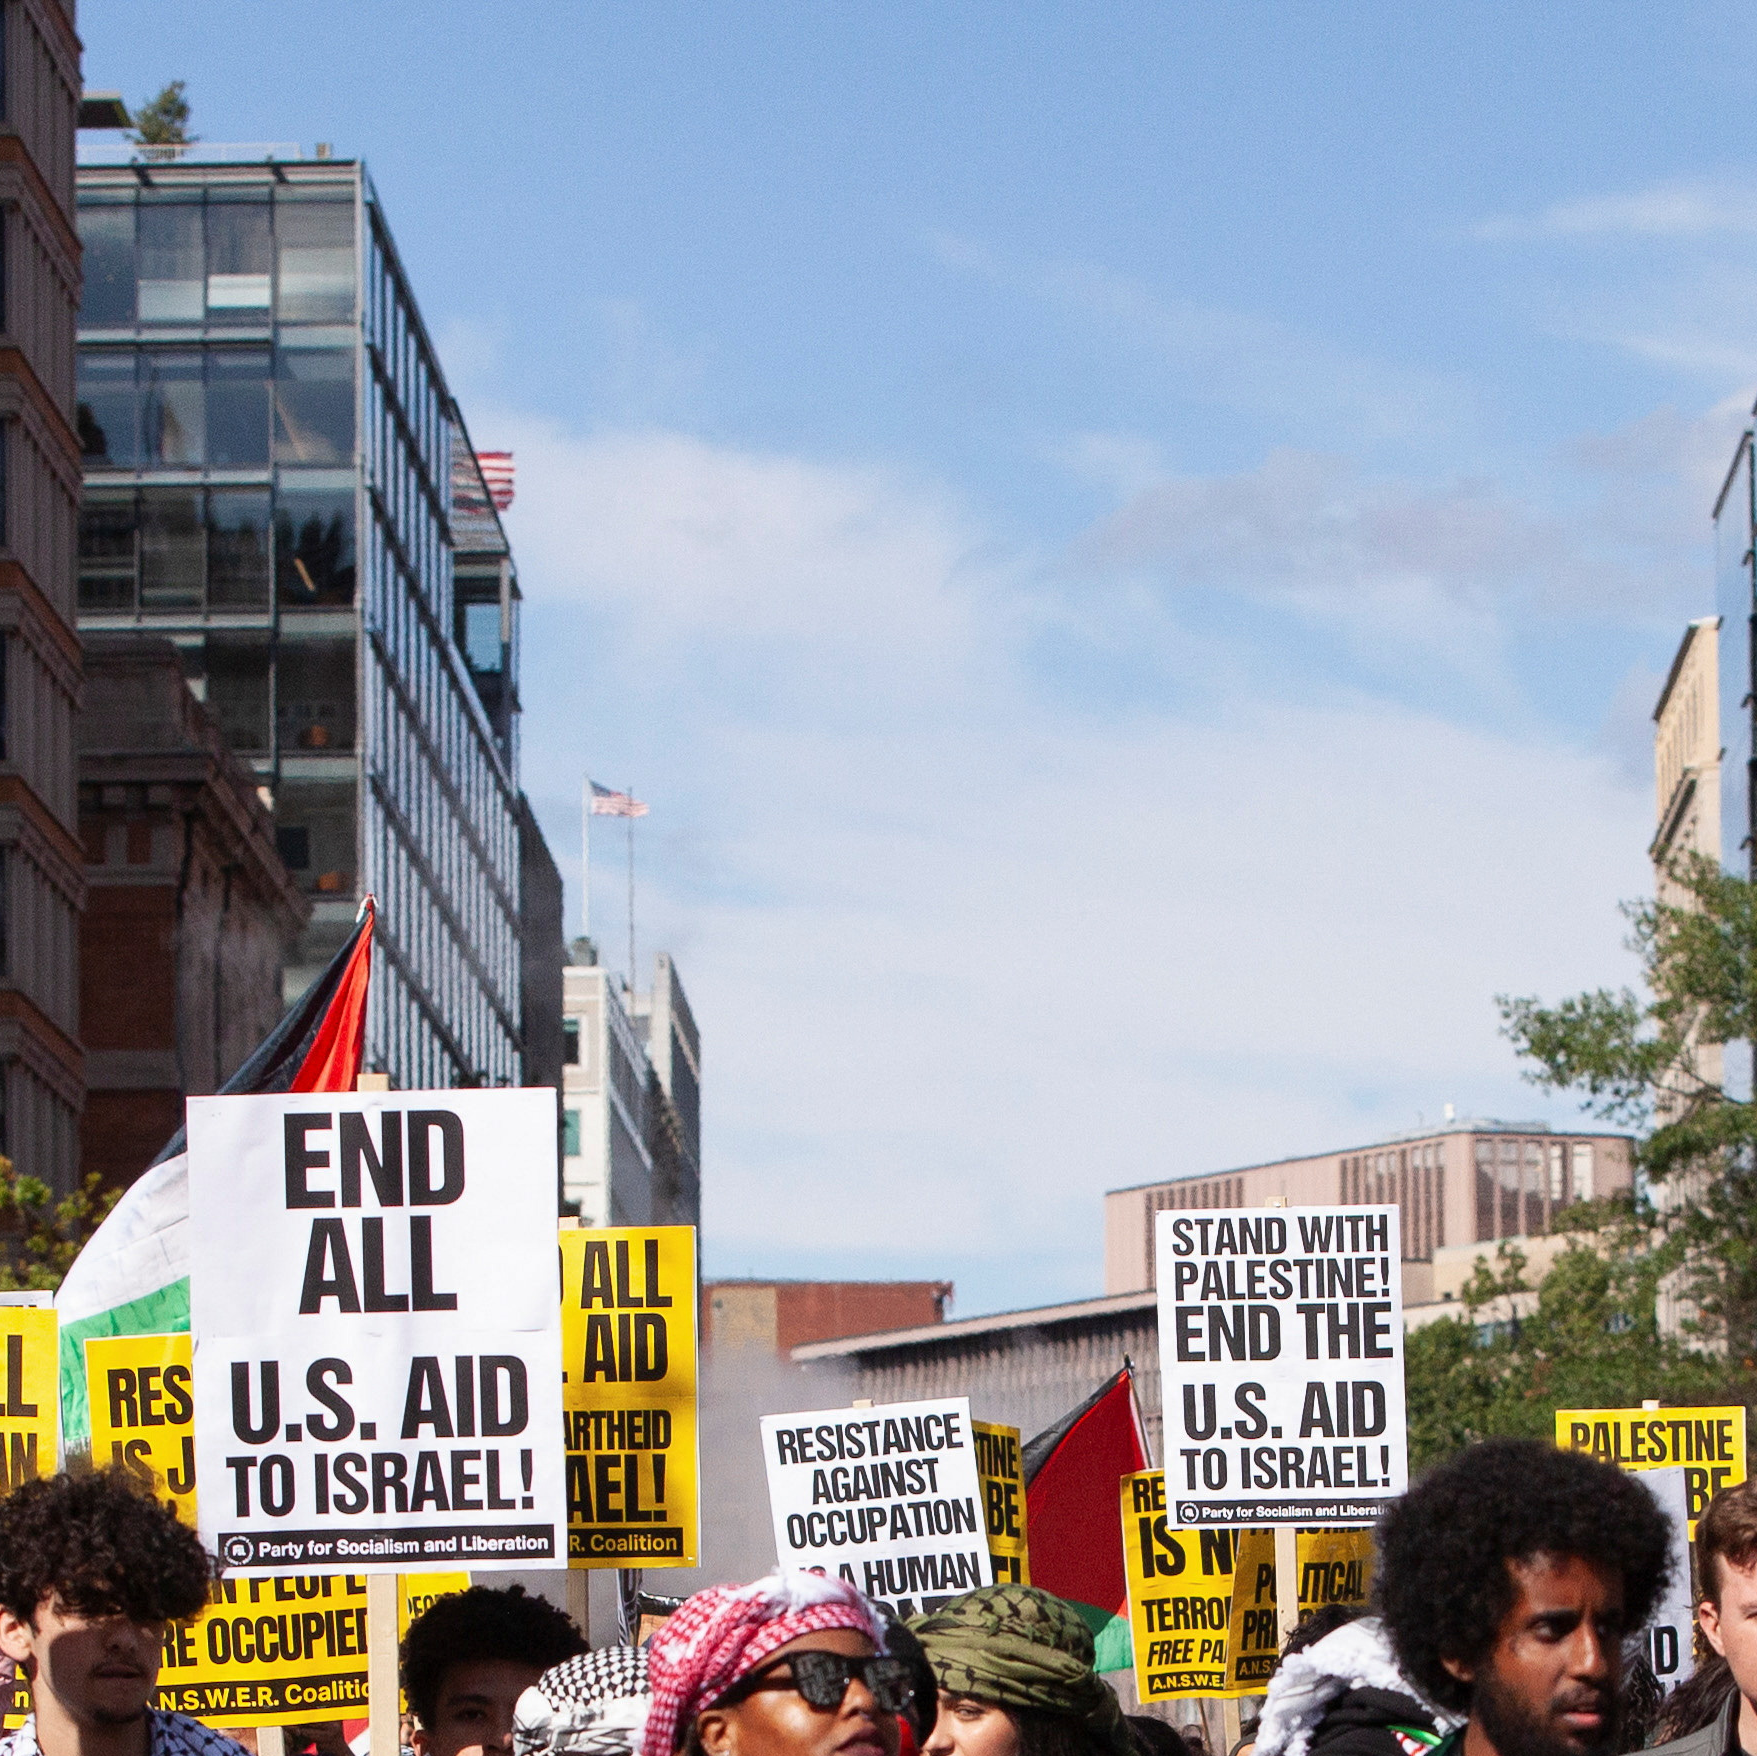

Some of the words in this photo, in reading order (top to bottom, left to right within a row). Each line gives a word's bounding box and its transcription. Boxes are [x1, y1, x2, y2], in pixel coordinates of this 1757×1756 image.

[284, 1109, 466, 1210] END
[1172, 1216, 1287, 1256] STAND
[1297, 1214, 1389, 1253] WITH
[298, 1215, 458, 1315] ALL
[580, 1239, 673, 1309] ALL
[1174, 1257, 1390, 1301] PALESTINE!
[583, 1312, 669, 1383] AID
[1175, 1304, 1281, 1362] END
[1296, 1302, 1393, 1360] THE
[230, 1357, 377, 1445] U.S.
[400, 1354, 529, 1440] AID
[1182, 1382, 1283, 1441] U.S.
[1299, 1380, 1387, 1438] AID
[775, 1412, 964, 1466] RESISTANCE
[1570, 1420, 1734, 1464] PALESTINE
[225, 1454, 296, 1518] TO
[313, 1448, 535, 1515] ISRAEL!
[812, 1457, 939, 1505] AGAINST
[1180, 1448, 1228, 1490] TO
[1240, 1445, 1391, 1489] ISRAEL!
[786, 1497, 978, 1549] OCCUPATION
[986, 1480, 1021, 1538] BE
[1202, 1507, 1234, 1520] Party
[1236, 1506, 1253, 1518] for
[1255, 1505, 1312, 1518] Socialism
[1315, 1505, 1337, 1517] and
[258, 1541, 304, 1558] Party
[307, 1539, 333, 1555] for
[336, 1536, 419, 1555] Socialism
[424, 1535, 457, 1552] and
[461, 1534, 549, 1551] Liberation
[590, 1532, 678, 1552] Coalition
[1138, 1515, 1186, 1578] IS
[863, 1551, 982, 1597] HUMAN
[1147, 1638, 1195, 1667] FREE
